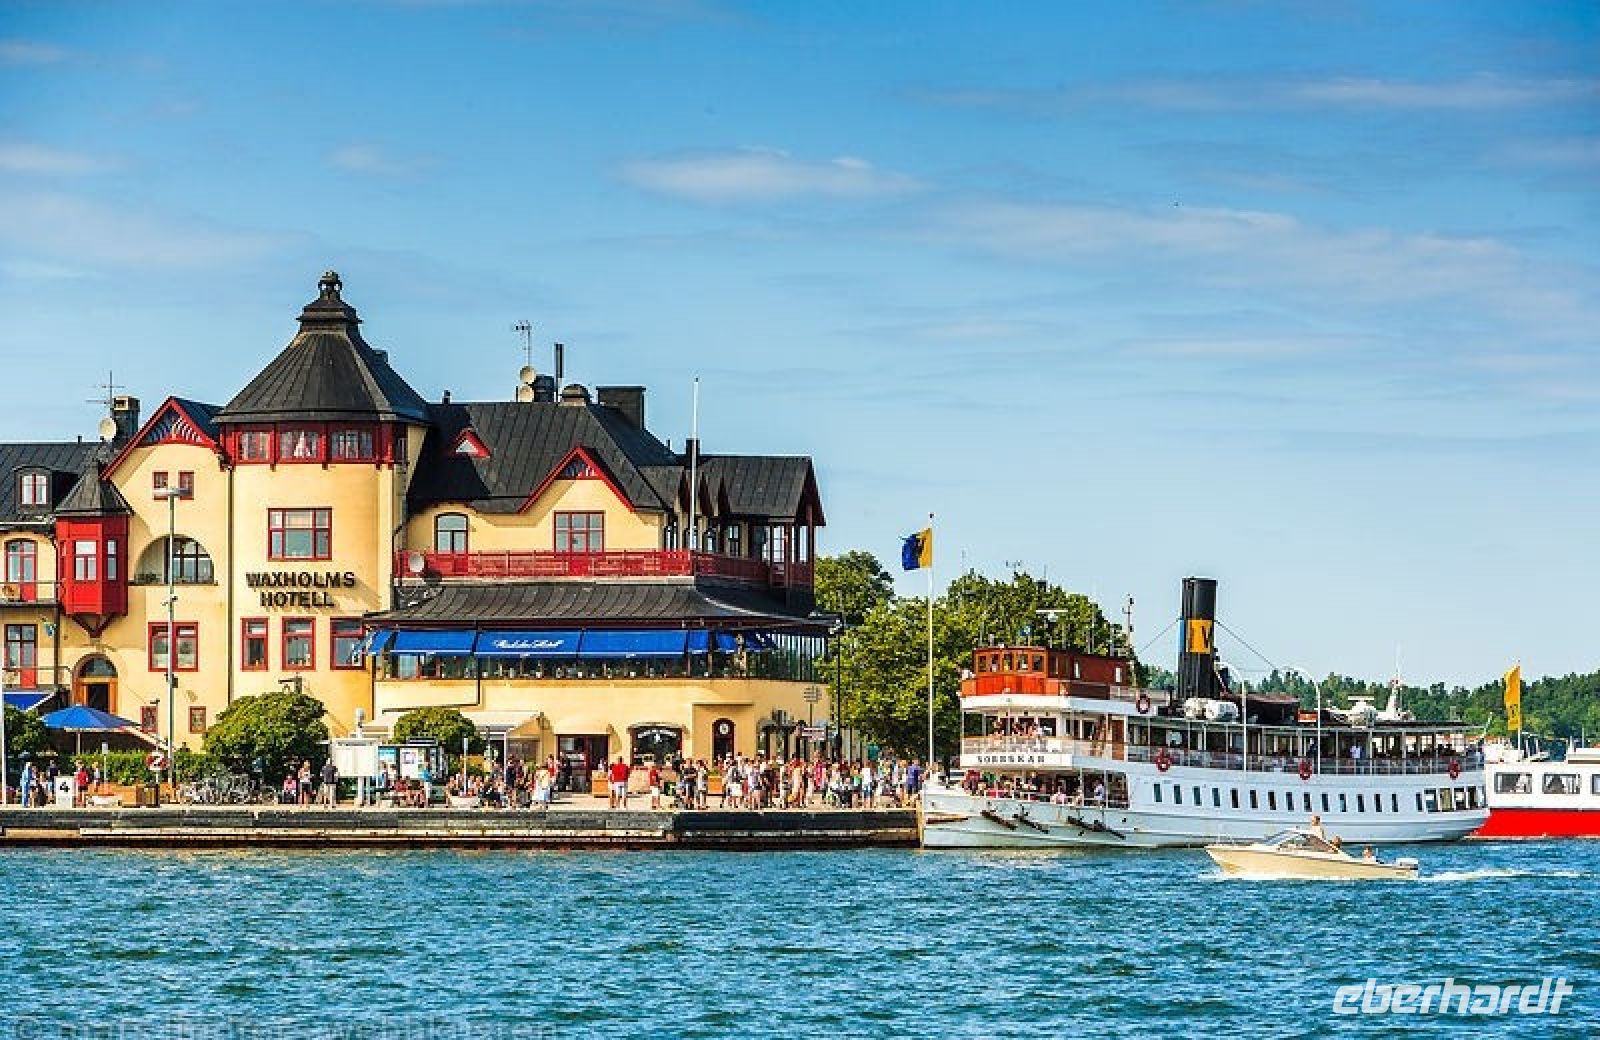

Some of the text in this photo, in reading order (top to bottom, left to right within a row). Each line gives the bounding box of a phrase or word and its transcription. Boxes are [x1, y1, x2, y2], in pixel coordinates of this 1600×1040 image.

[246, 571, 355, 588] WAXHOLMS
[260, 592, 335, 608] HOTELL
[59, 781, 70, 793] 4
